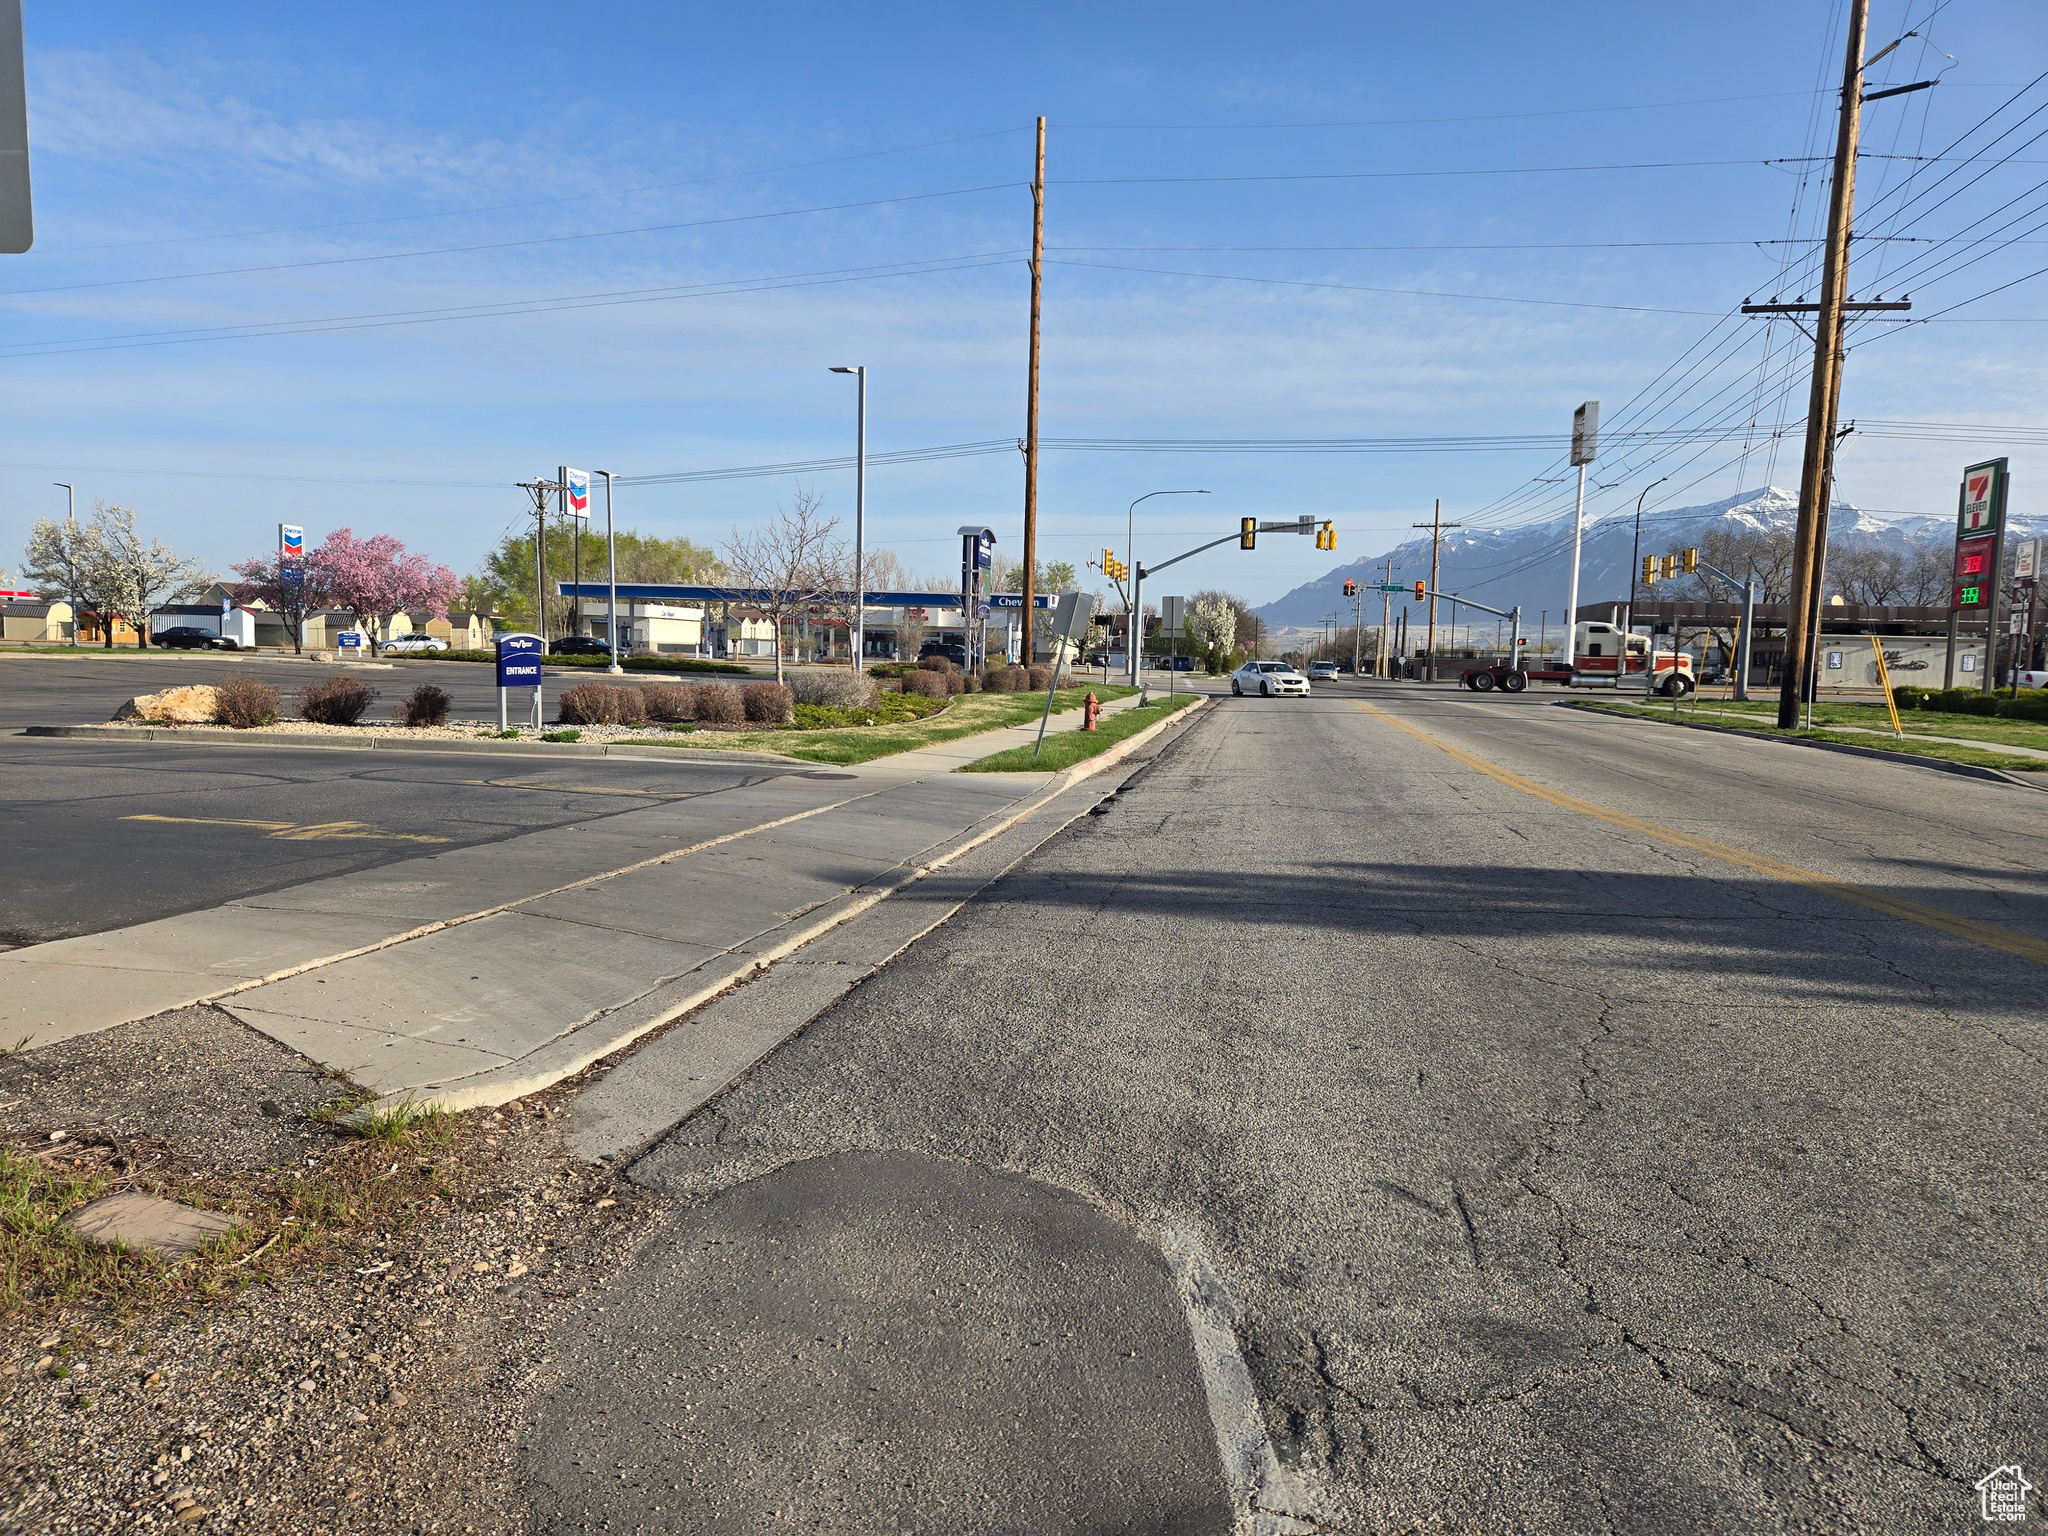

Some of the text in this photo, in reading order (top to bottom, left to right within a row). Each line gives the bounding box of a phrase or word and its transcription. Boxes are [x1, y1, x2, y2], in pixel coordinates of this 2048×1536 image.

[569, 471, 587, 482] Chevron
[1968, 475, 1989, 530] 7
[998, 596, 1040, 607] Chevn
[506, 666, 537, 675] ENTRANCE
[1886, 661, 1928, 671] Frontier
